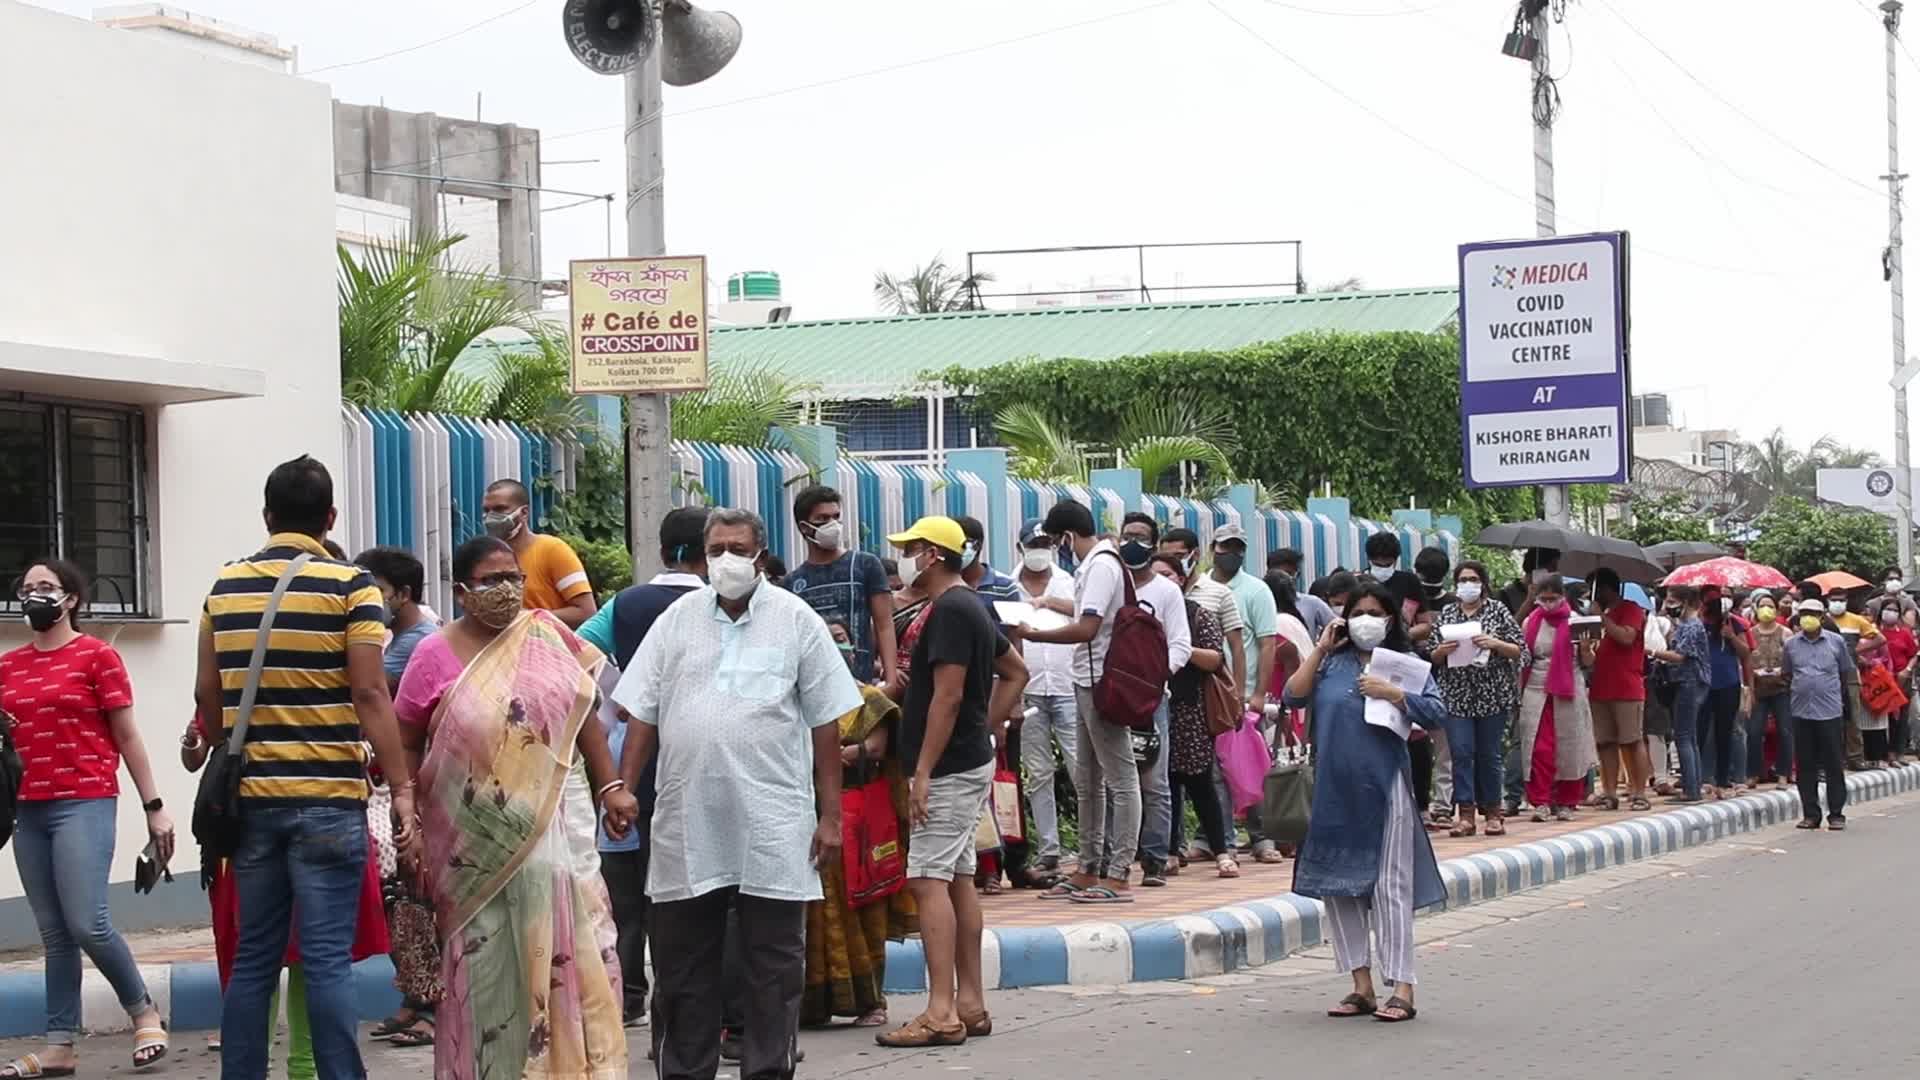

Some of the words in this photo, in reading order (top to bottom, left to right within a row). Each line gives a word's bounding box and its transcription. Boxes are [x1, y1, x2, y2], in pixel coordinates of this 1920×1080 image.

[570, 22, 635, 69] ELECTRIC
[1522, 262, 1588, 285] MEDICA
[1517, 294, 1564, 312] COVID
[581, 313, 595, 331] #
[604, 311, 660, 331] Café
[669, 310, 698, 329] de
[1489, 317, 1593, 340] VACCINATION
[583, 335, 697, 353] CROSSPOINT
[1512, 344, 1571, 364] CENTRE
[608, 367, 640, 377] Kolkata
[642, 367, 657, 376] 700
[1532, 386, 1557, 404] AT
[1476, 429, 1542, 445] KISHORE
[1547, 425, 1612, 441] BHARATI
[1499, 448, 1590, 466] KRIRANGAN
